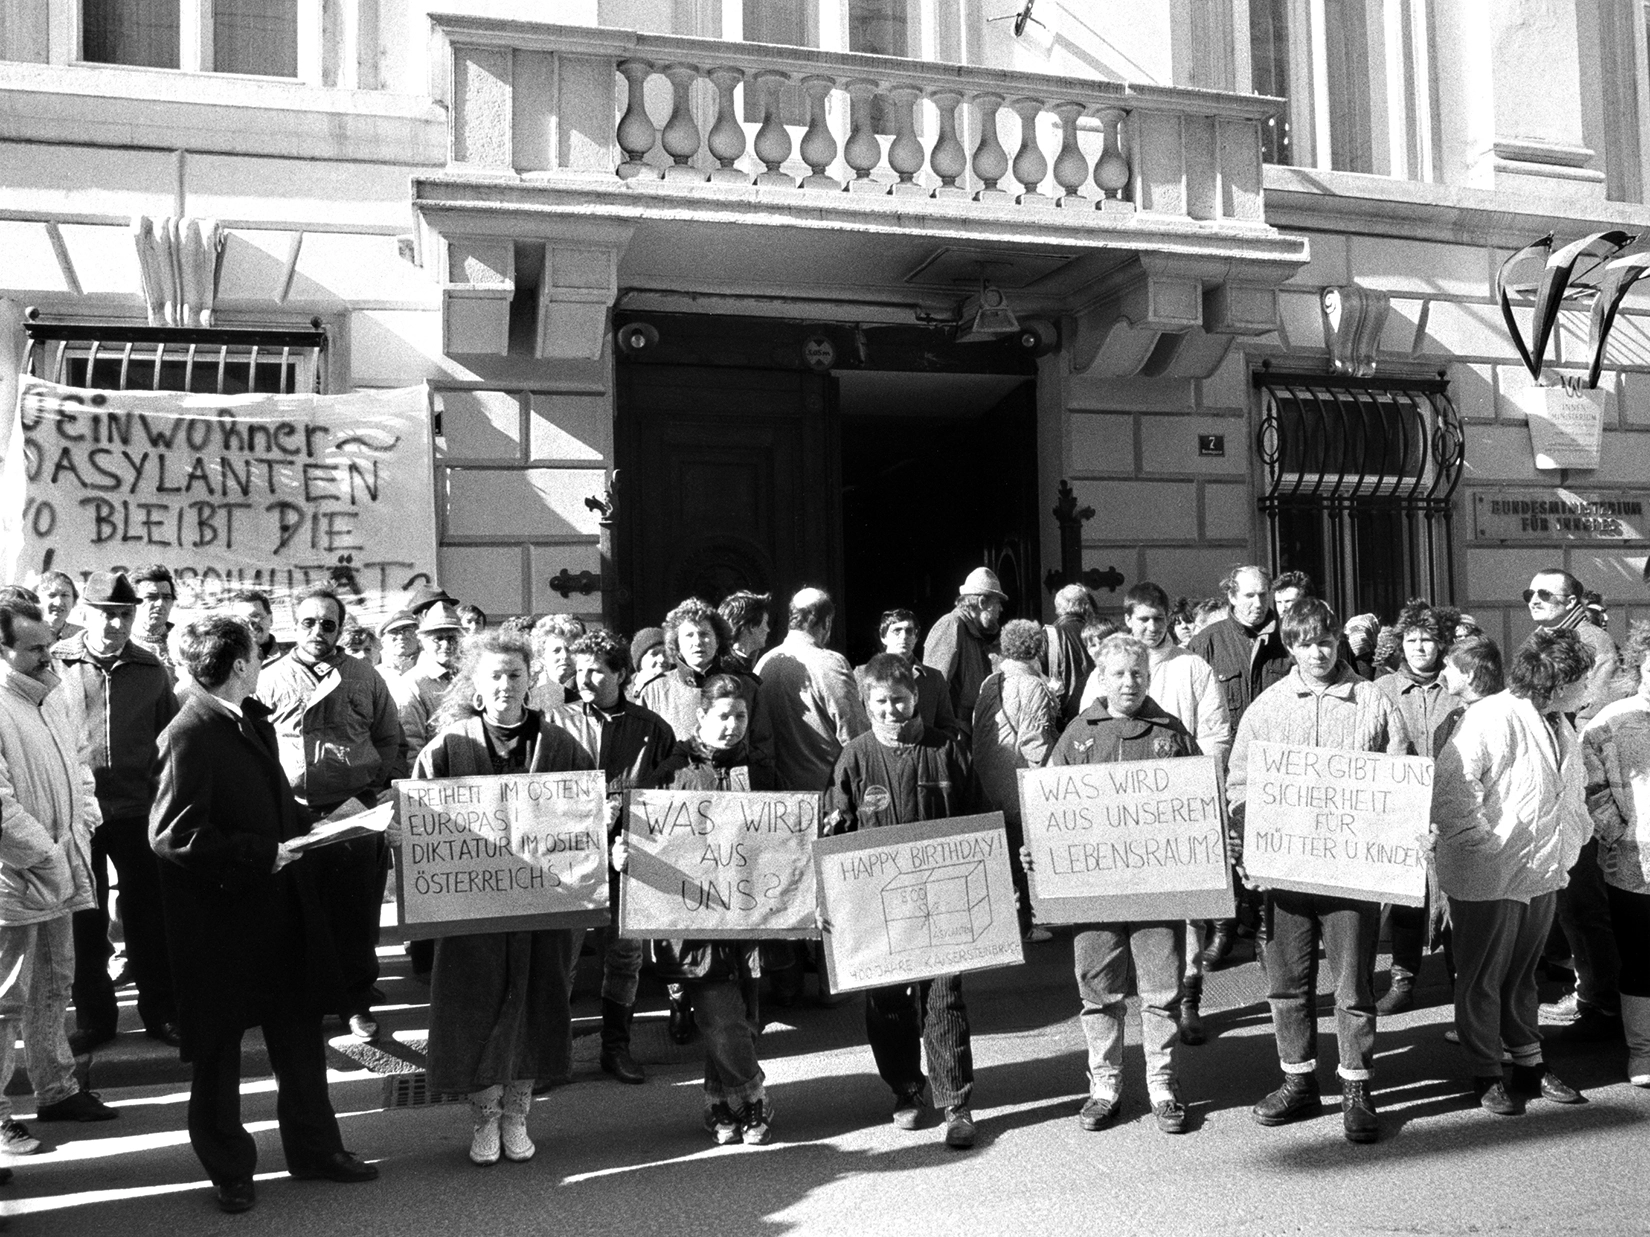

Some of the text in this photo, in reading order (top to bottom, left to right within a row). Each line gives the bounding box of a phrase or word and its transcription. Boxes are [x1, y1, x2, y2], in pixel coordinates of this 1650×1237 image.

[51, 446, 379, 506] ASYLANTEN
[79, 497, 251, 549] BLEIBT
[265, 501, 364, 555] DIE
[1521, 514, 1549, 532] FÜR
[1039, 767, 1170, 802] WAS WIRD
[1263, 748, 1434, 787] WER GIBT UNS
[407, 779, 591, 808] FREIHEIT IM OSTEN
[1262, 782, 1392, 814] SICHERHEIT
[642, 800, 815, 837] WAS WIRD
[1046, 796, 1218, 833] AUS UNSEREM
[1315, 812, 1357, 836] FÜR
[411, 831, 600, 865] DIKTATUR IM OSTEN
[700, 842, 748, 868] AUS
[1049, 828, 1221, 876] LEBENSRAUM?
[1256, 827, 1337, 859] MÜTTER
[1366, 841, 1425, 870] KINDER
[841, 850, 902, 882] HAPPY
